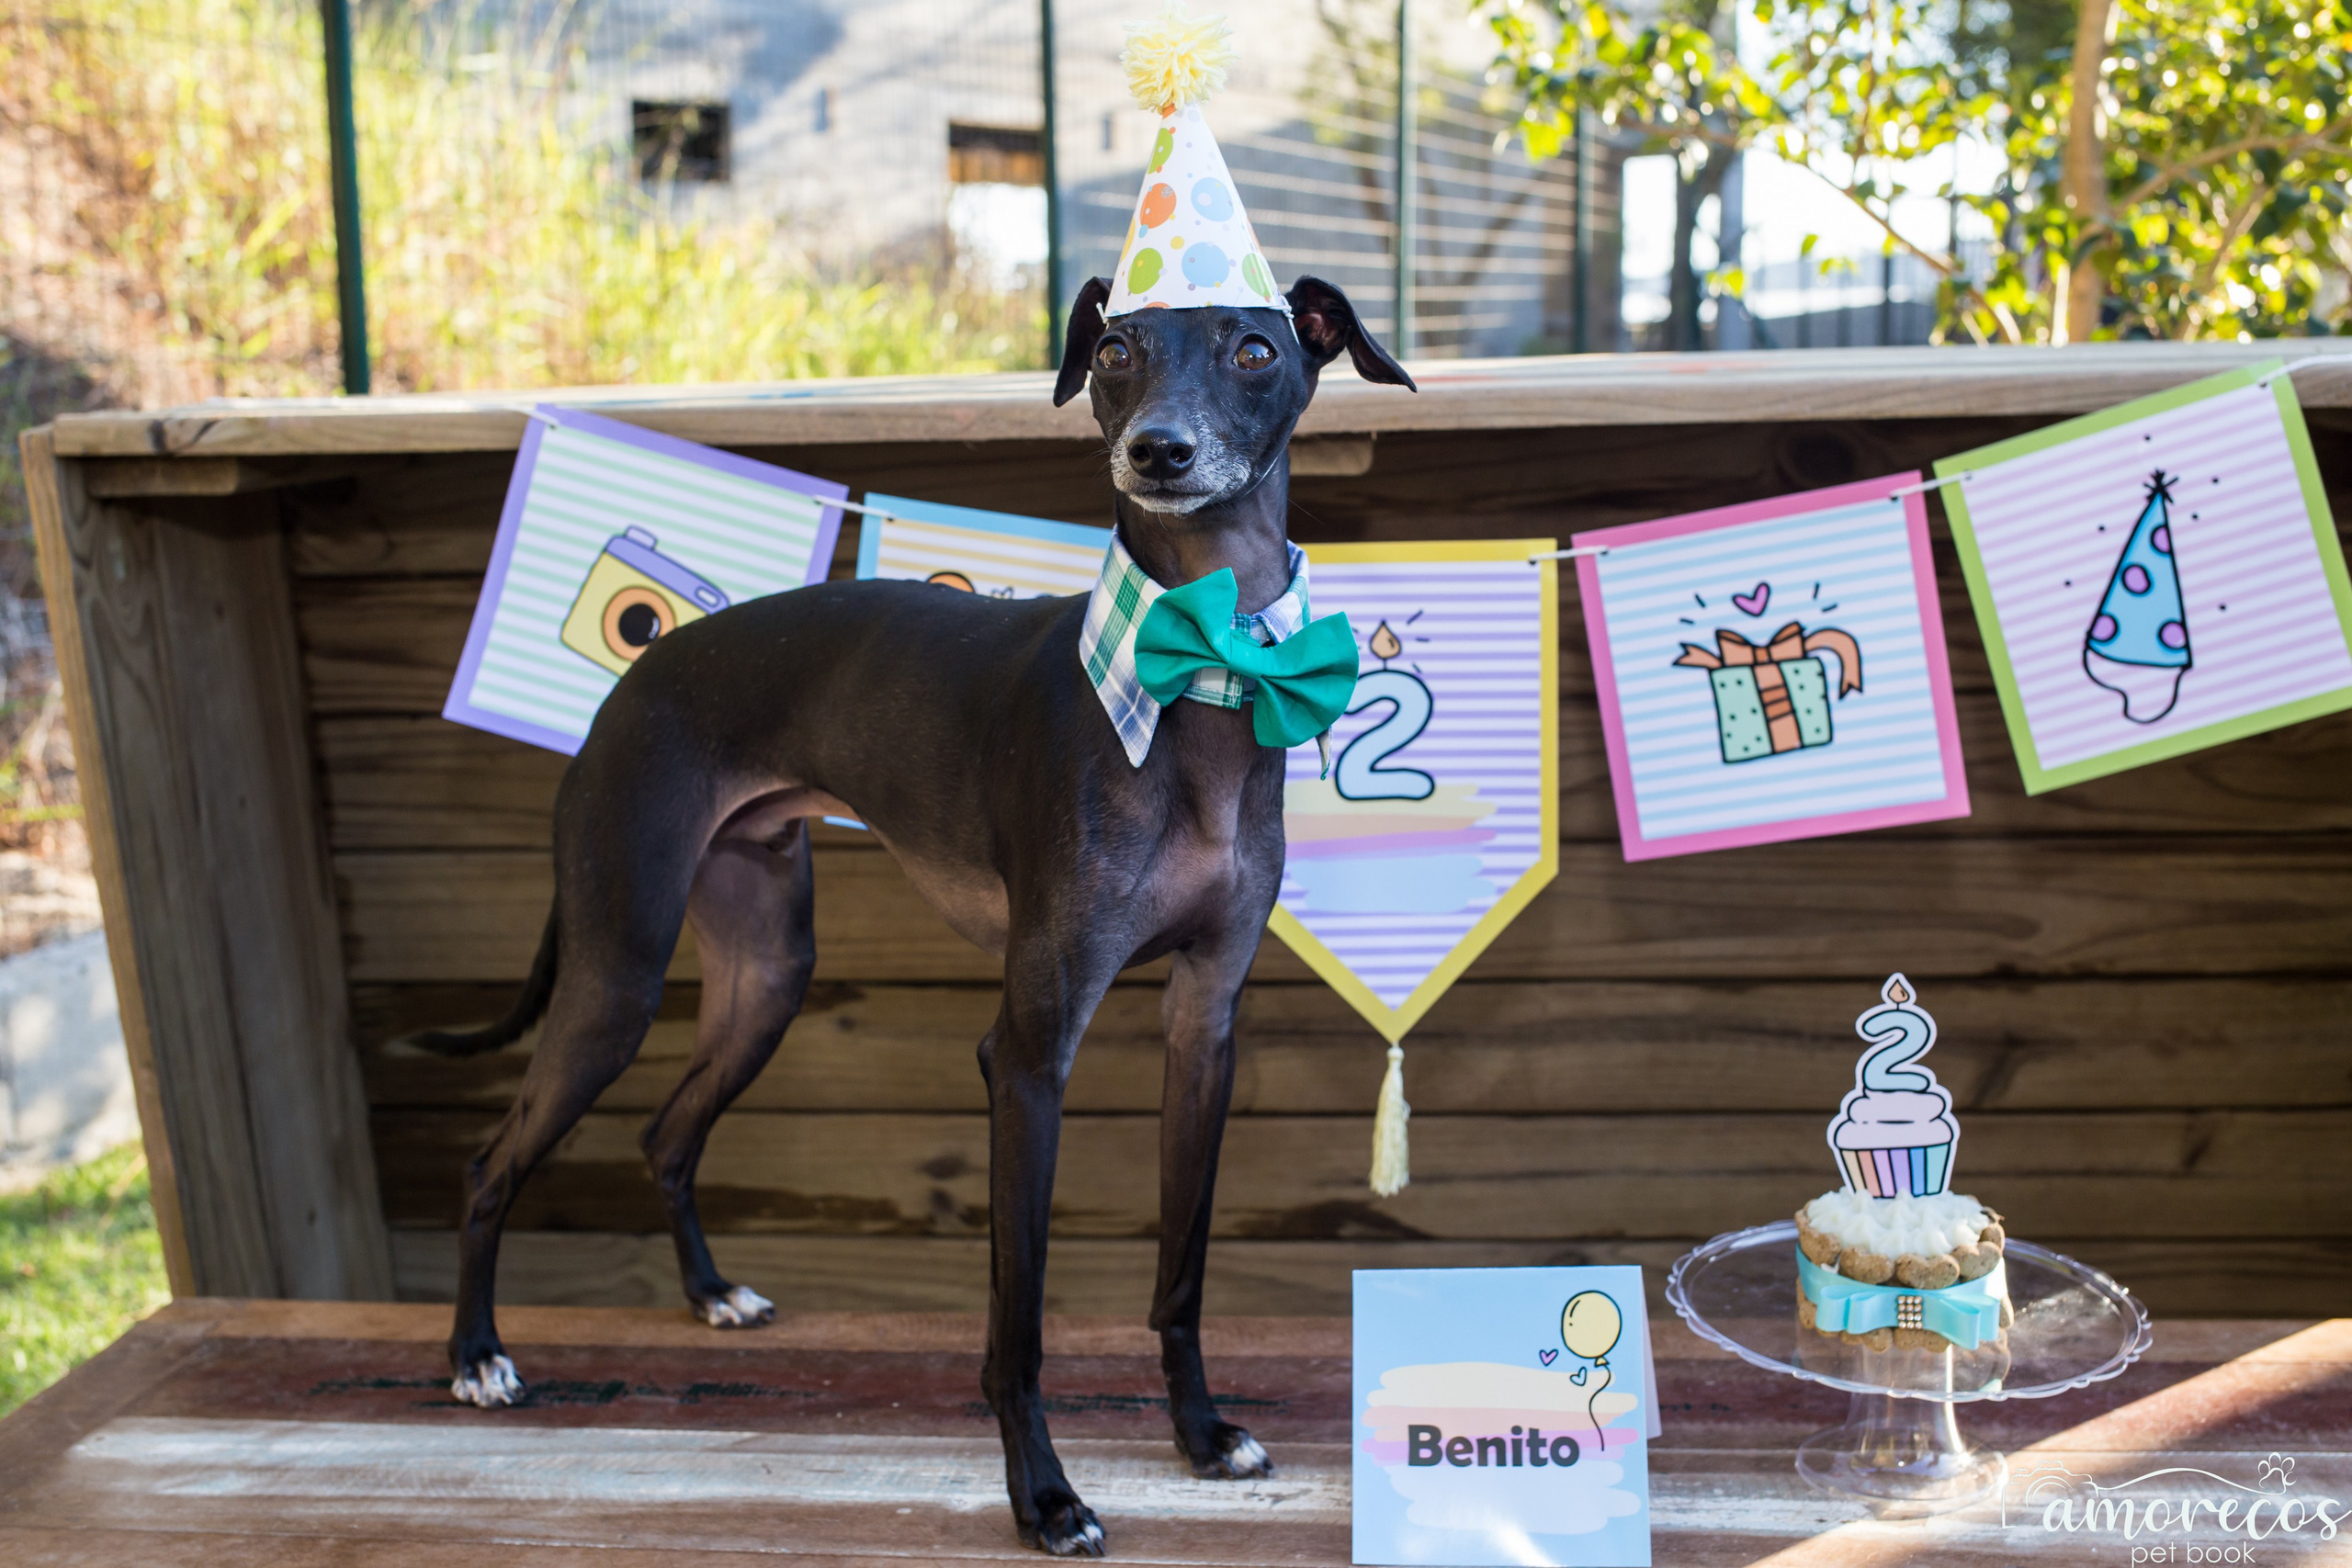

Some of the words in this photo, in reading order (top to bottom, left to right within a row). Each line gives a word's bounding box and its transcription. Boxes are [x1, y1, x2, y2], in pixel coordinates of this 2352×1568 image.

[1336, 669, 1435, 800] 2
[1862, 1010, 1930, 1091] 2
[1407, 1424, 1580, 1468] Benito
